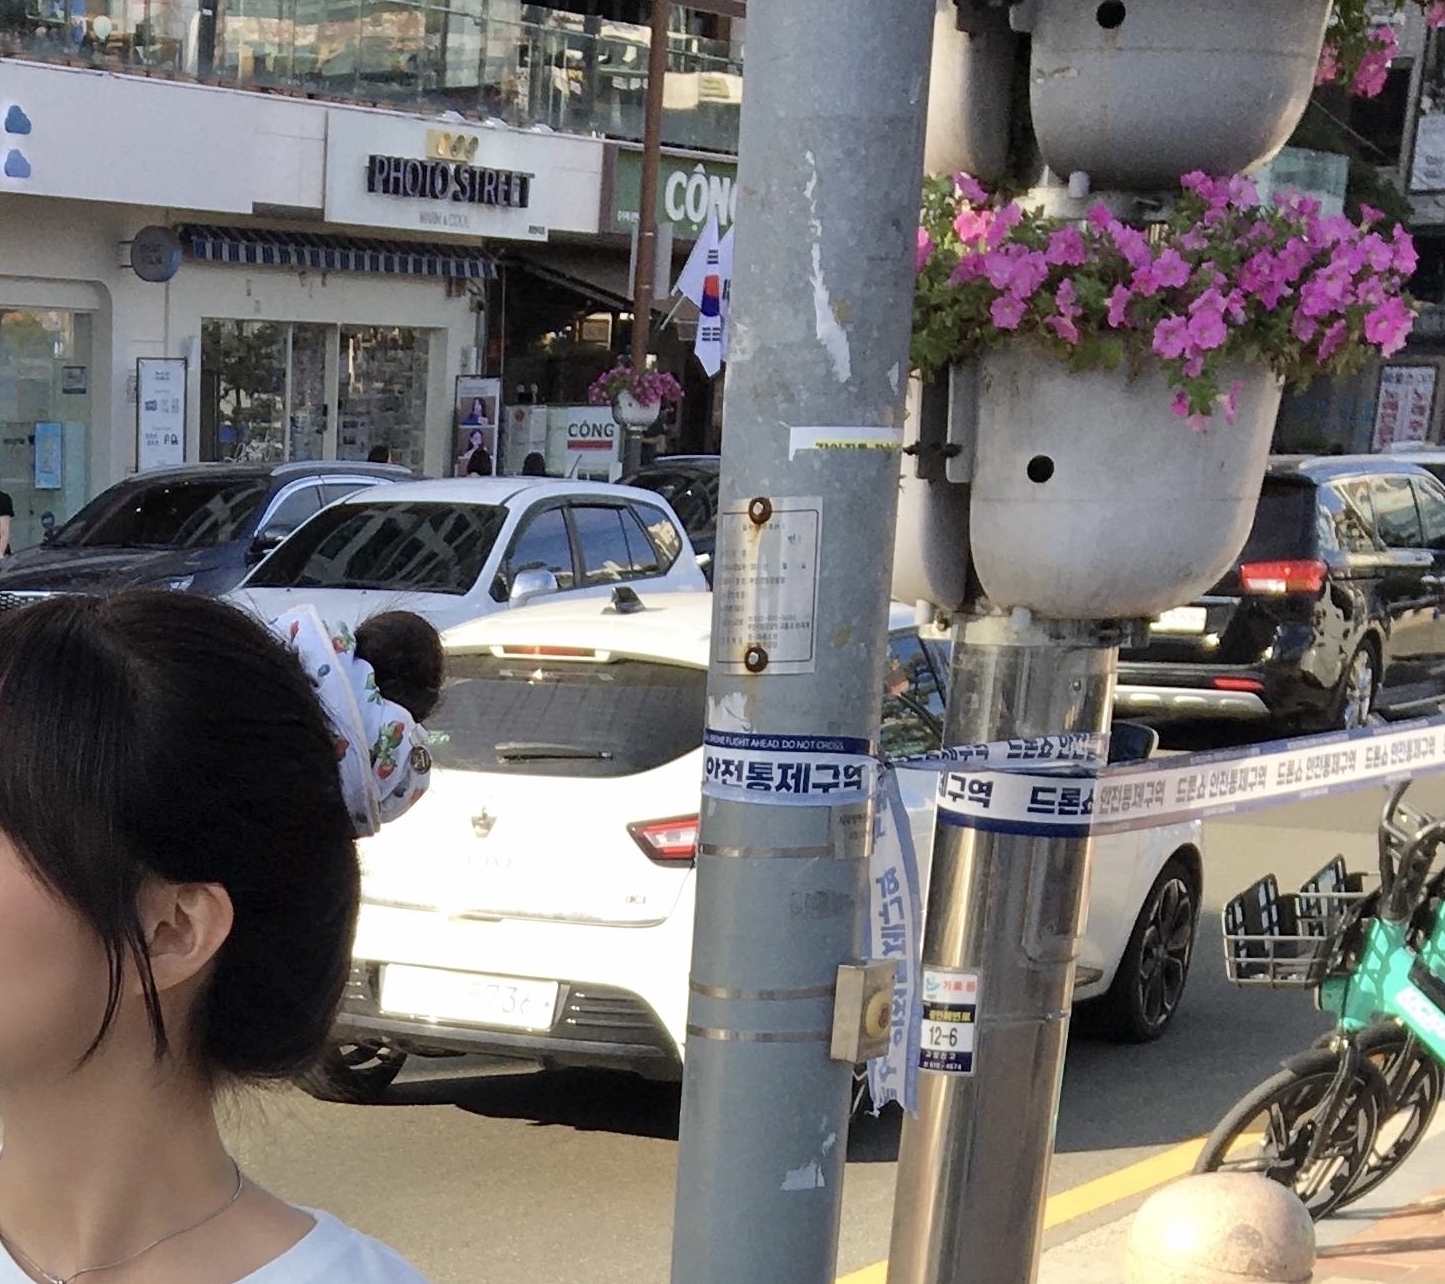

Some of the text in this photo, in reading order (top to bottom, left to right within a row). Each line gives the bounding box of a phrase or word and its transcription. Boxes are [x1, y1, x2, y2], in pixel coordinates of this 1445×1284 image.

[369, 155, 534, 208] PHOTO STREET
[725, 736, 749, 747] FLIGHT
[782, 739, 795, 749] DO
[797, 740, 815, 750] NOT
[706, 756, 867, 794] 안전통제구역
[1100, 779, 1166, 815] 안전통제구역
[1176, 773, 1206, 802] 드론쇼
[1209, 764, 1268, 798] 안전통제구역
[1276, 761, 1303, 786] 드론쇼
[1306, 749, 1357, 781] 안전통제구역
[1365, 745, 1389, 769] 드론쇼
[1391, 736, 1436, 765] 안전통제구역
[929, 1025, 958, 1047] 12-6
